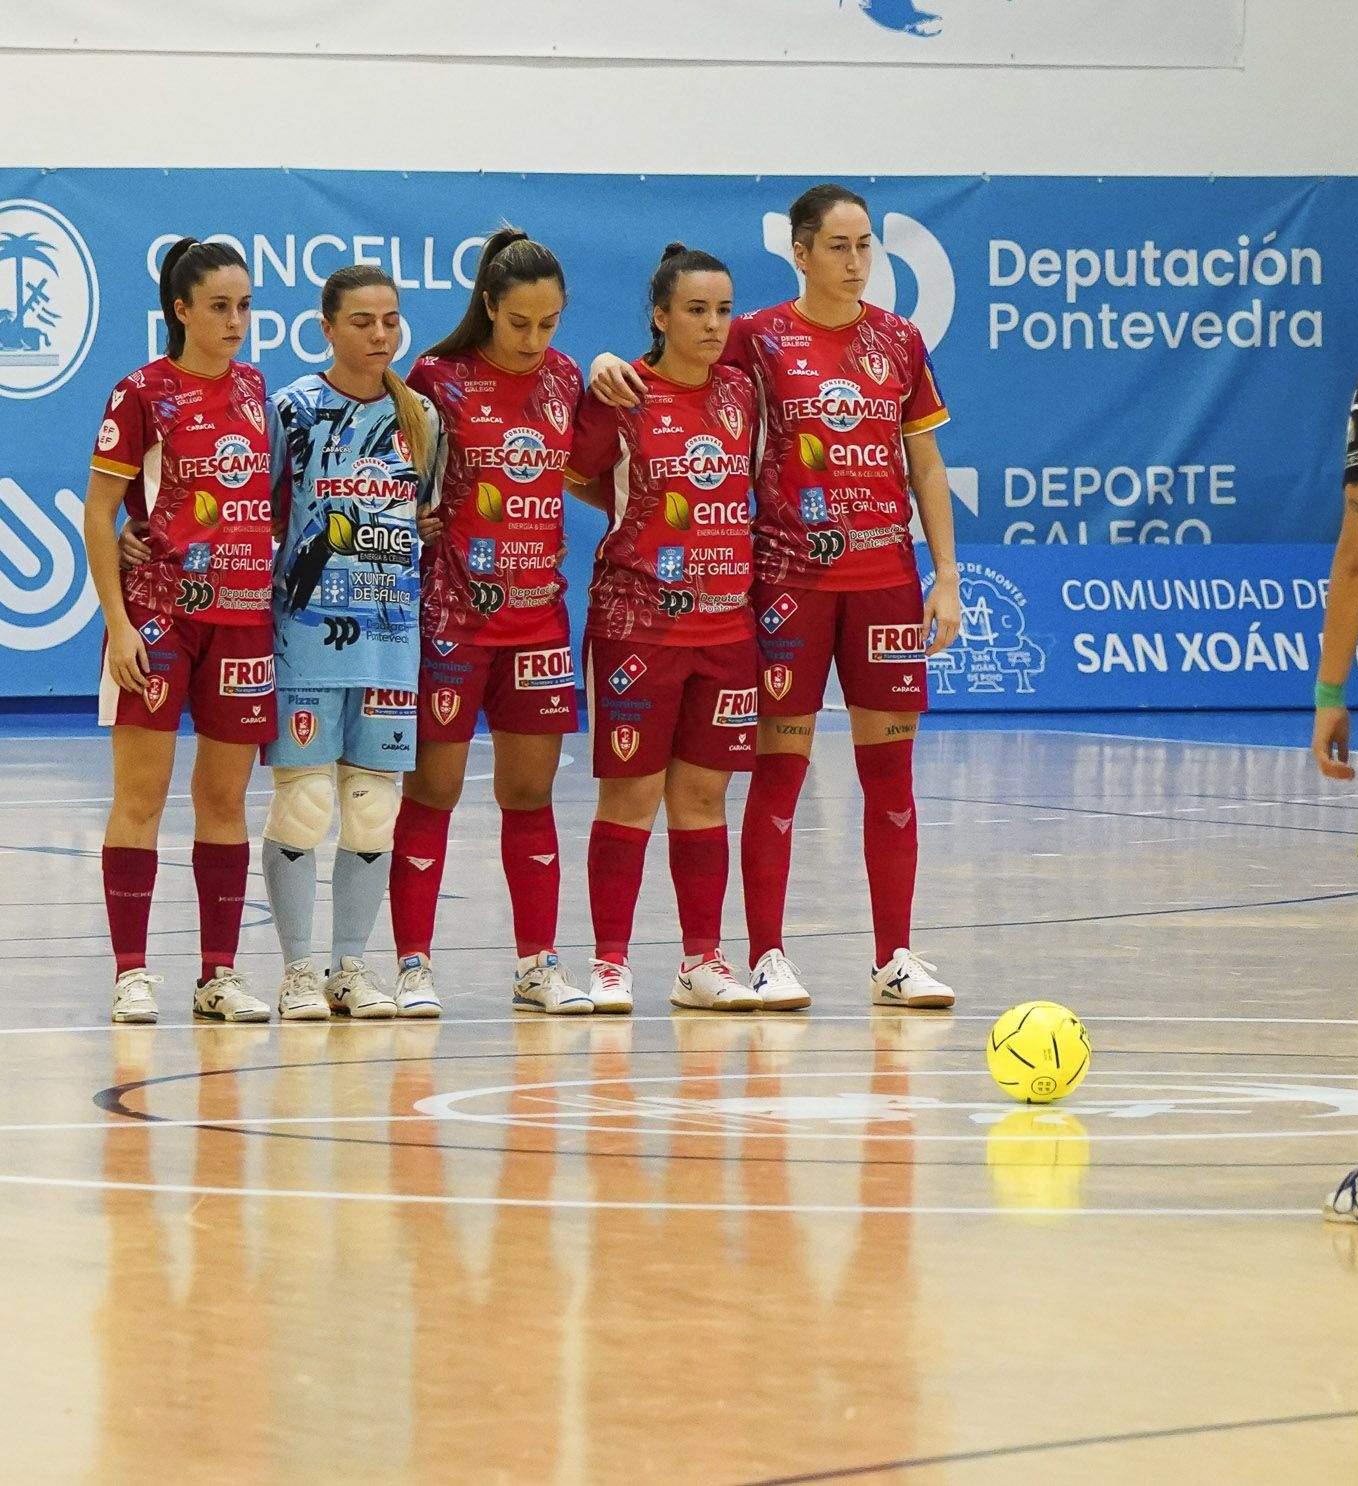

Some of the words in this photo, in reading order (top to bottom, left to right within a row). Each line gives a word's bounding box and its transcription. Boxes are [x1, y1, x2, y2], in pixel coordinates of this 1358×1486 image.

[989, 230, 1322, 303] Deputación
[989, 299, 1324, 350] Pontevedra
[784, 398, 897, 421] PESCAMAR
[471, 416, 504, 424] CARACAL
[652, 426, 684, 435] CARACAL
[829, 444, 889, 467] ence
[180, 453, 271, 479] PESCAMA
[1004, 464, 1237, 507] DEPORTE
[222, 500, 271, 522] ence
[506, 495, 561, 519] ence
[693, 501, 748, 525] ence
[831, 502, 849, 514] DE
[356, 525, 412, 550] ence
[215, 543, 252, 556] XUNTA
[501, 541, 544, 554] XUNTA
[690, 548, 733, 561] XUNTA
[213, 558, 229, 570] DE
[500, 556, 519, 569] DE
[689, 562, 705, 575] DE
[708, 561, 749, 575] GALICIA
[353, 572, 396, 586] XUNTA
[353, 588, 372, 601] DE
[1062, 578, 1285, 611] COMUNIDAD
[1074, 631, 1166, 674] SAN
[1175, 622, 1310, 673] XOÁN
[288, 694, 319, 706] Pizza
[381, 743, 410, 751] CARACAL
